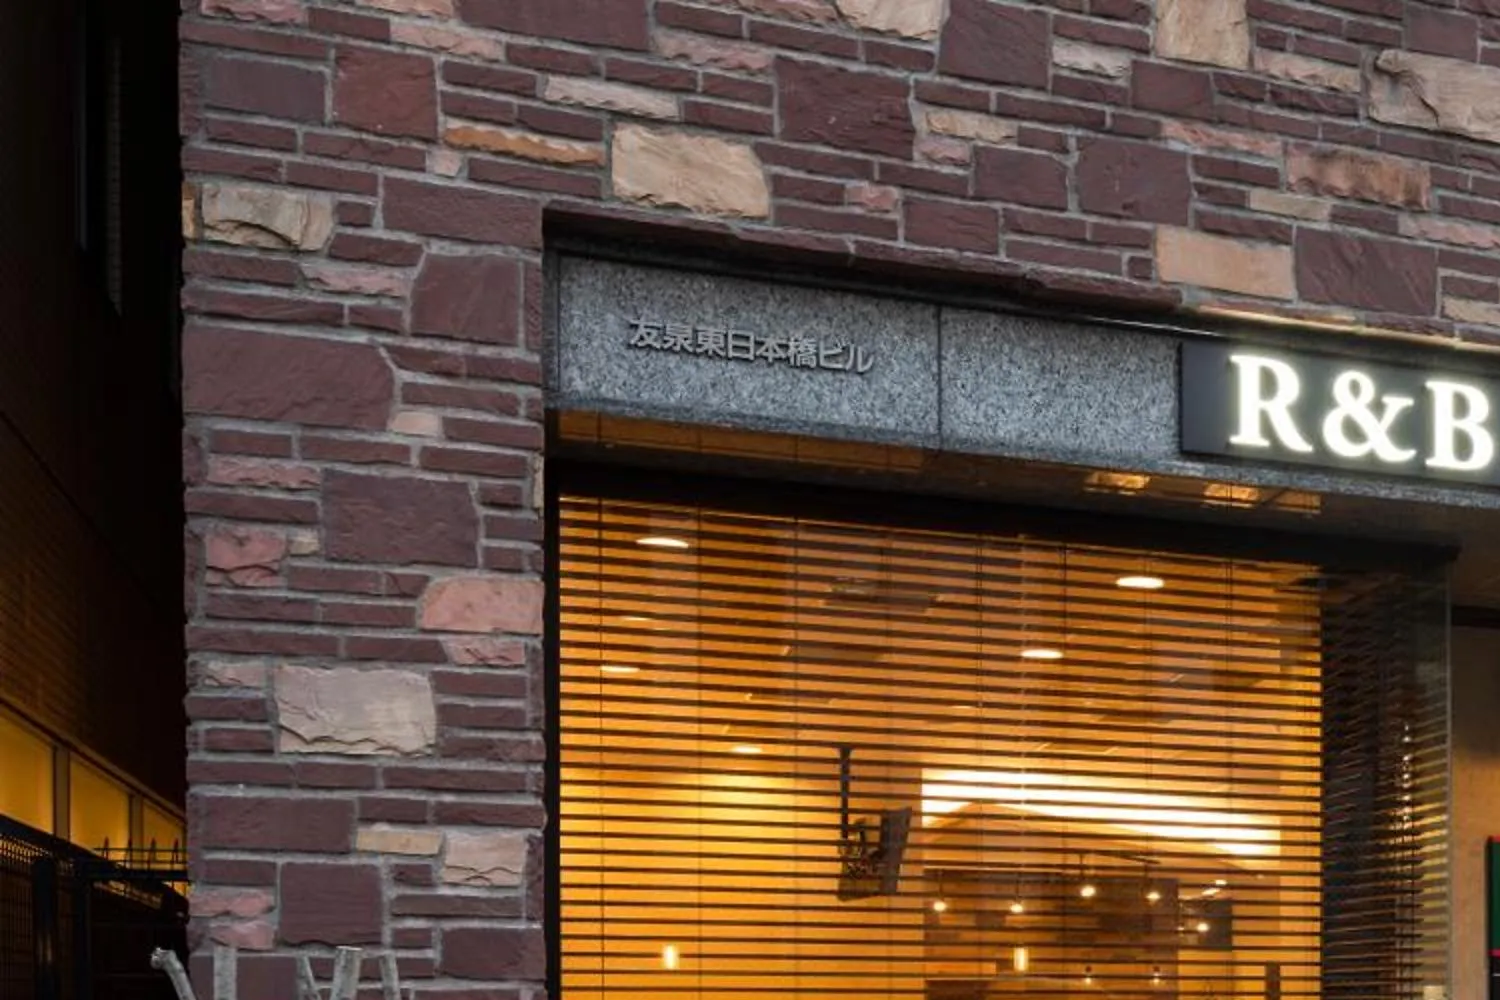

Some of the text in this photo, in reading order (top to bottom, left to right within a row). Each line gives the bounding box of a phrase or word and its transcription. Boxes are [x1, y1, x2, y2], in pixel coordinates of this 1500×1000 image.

[628, 314, 874, 374] 友泉東日本橋ビル
[1228, 353, 1496, 473] R&B
